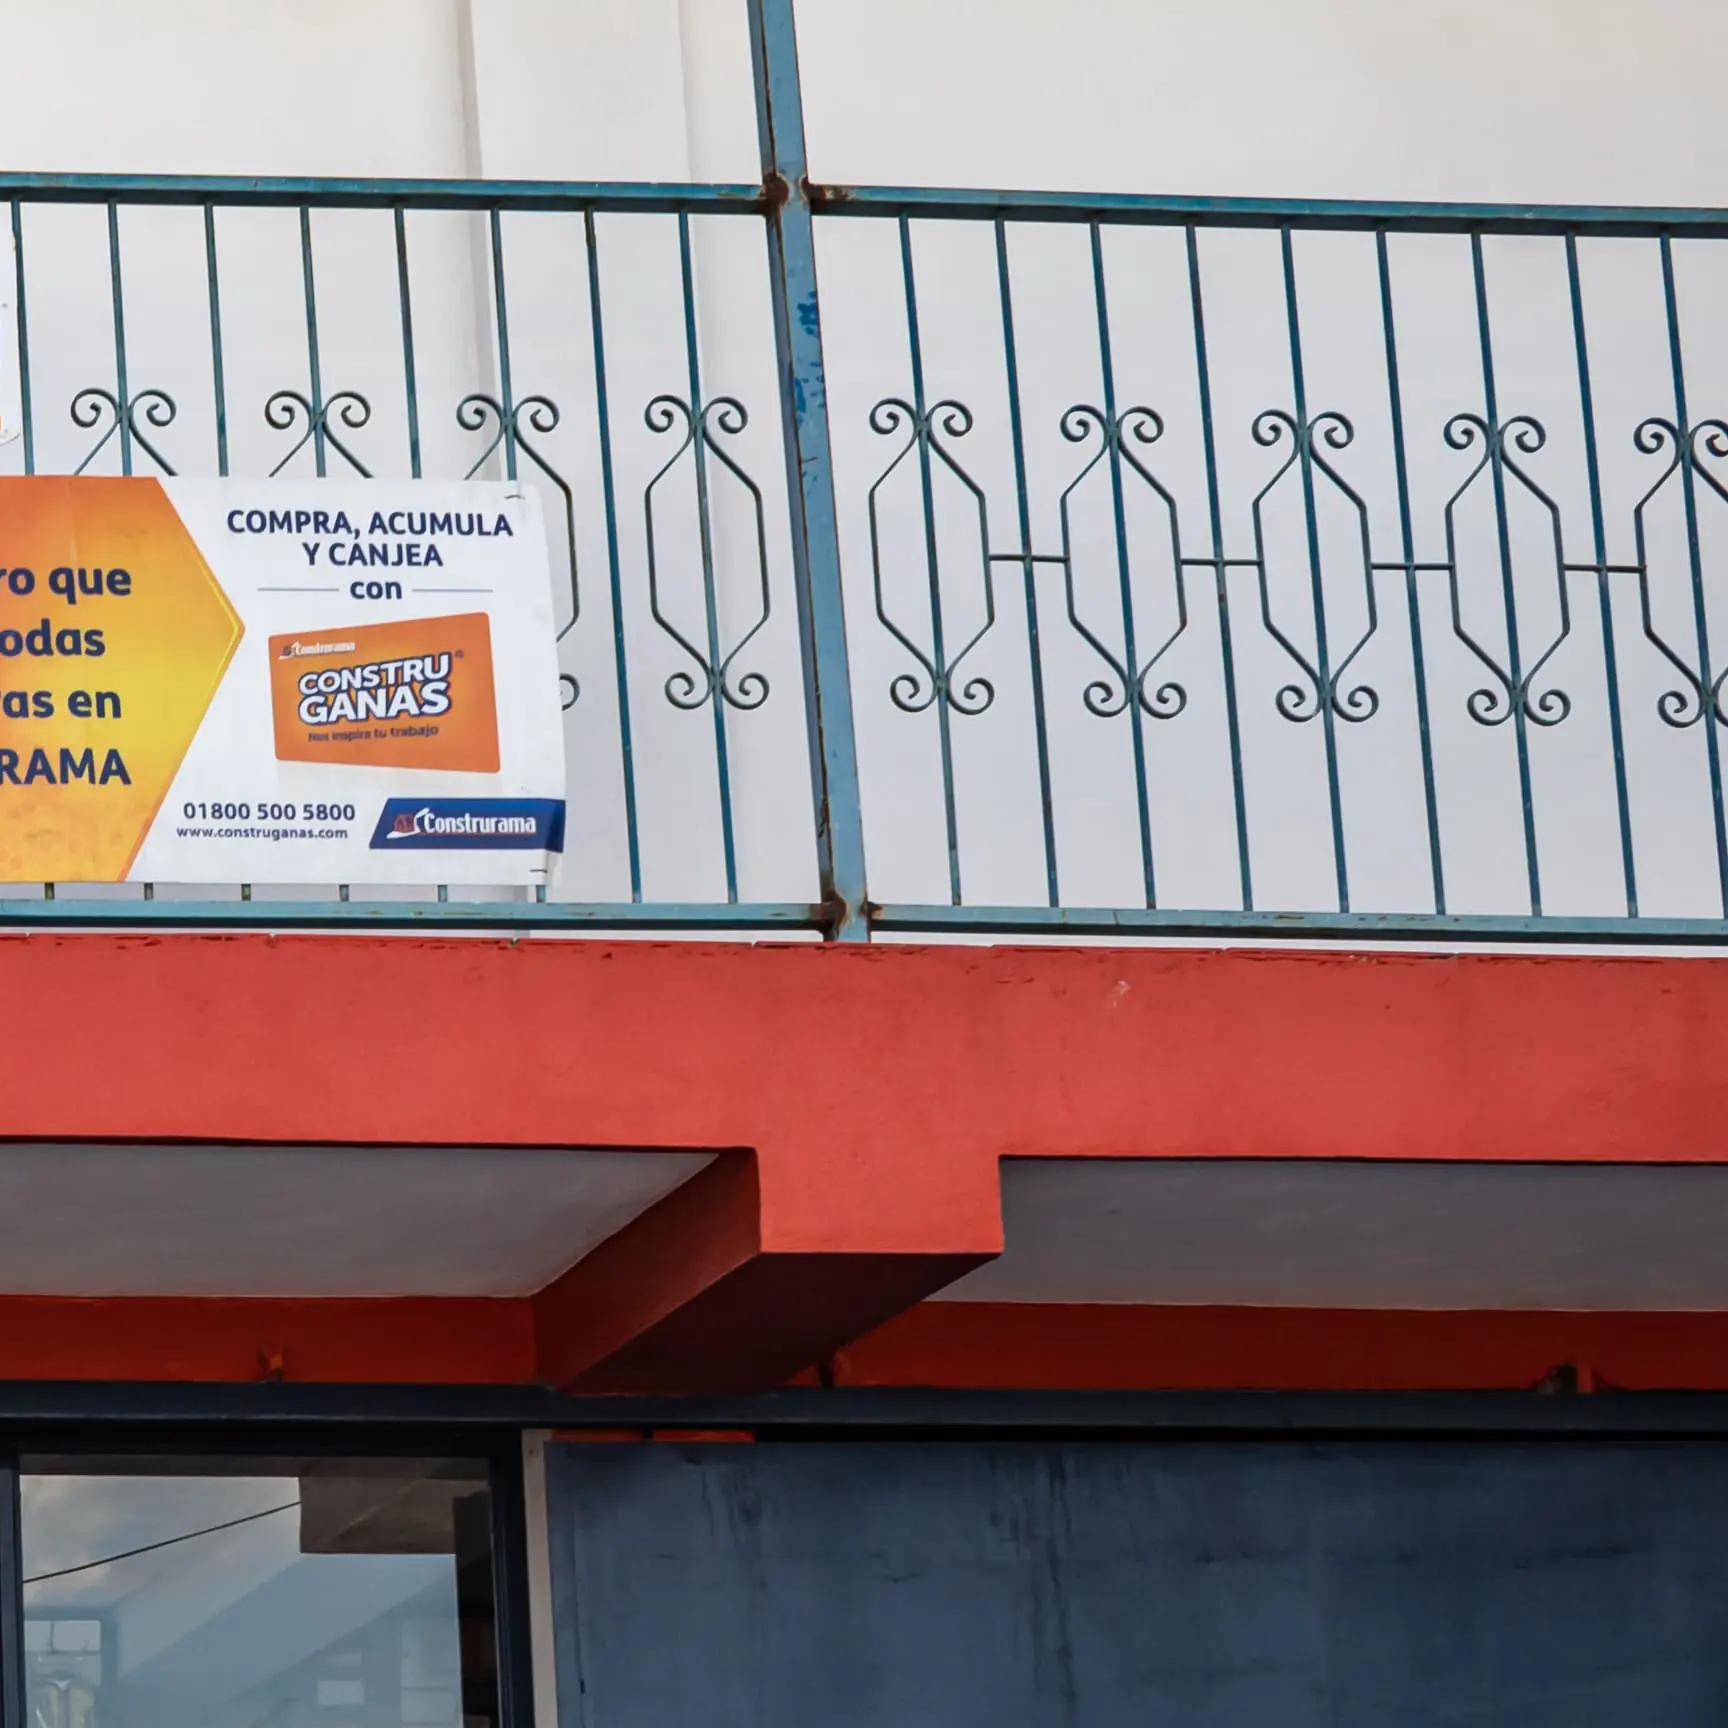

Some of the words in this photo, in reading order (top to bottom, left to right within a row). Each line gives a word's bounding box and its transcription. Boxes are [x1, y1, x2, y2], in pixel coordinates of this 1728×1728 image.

[227, 510, 360, 539] COMPRA,
[368, 512, 513, 536] ACUMULA
[302, 543, 320, 565] Y
[329, 543, 443, 566] CANJEA
[49, 567, 132, 604] que
[350, 581, 402, 599] con
[299, 652, 451, 695] CONSTRU
[68, 690, 121, 718] en
[299, 681, 451, 724] GANAS
[332, 730, 370, 741] inspira
[374, 728, 387, 738] tu
[390, 726, 439, 741] trabajo
[183, 803, 251, 820] 01800
[257, 803, 299, 821] 500
[302, 804, 356, 822] 5800
[422, 813, 537, 834] Construrama
[176, 827, 348, 840] www.construganas.com
